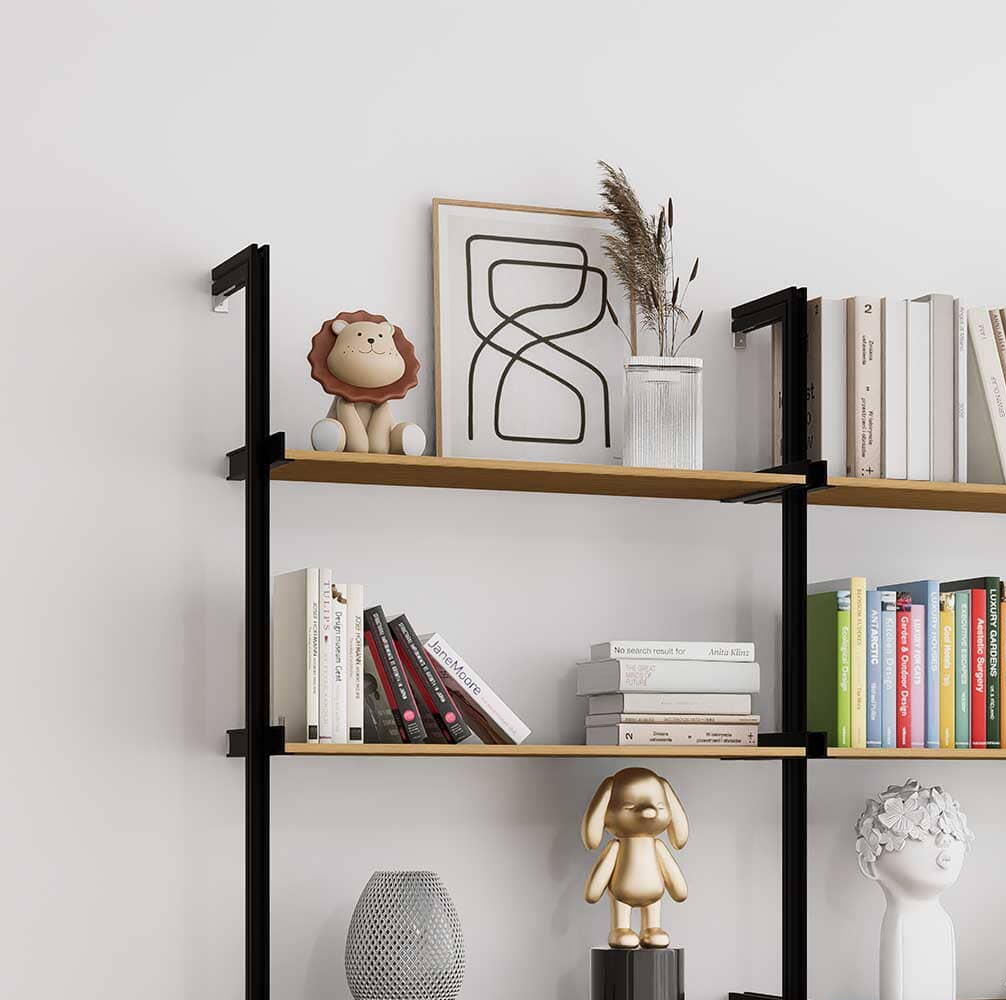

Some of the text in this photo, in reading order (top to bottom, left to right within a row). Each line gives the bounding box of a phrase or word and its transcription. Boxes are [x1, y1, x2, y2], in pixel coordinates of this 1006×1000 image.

[864, 304, 872, 314] 2
[323, 580, 331, 631] TULIPS
[334, 611, 342, 635] Design
[871, 609, 879, 664] ANTARCTIC
[886, 617, 894, 656] Kitchen
[901, 616, 909, 644] Garden
[614, 646, 686, 655] No search result for
[708, 647, 729, 657] Anita
[901, 654, 909, 688] Outdoor
[975, 656, 985, 694] Surgery
[899, 690, 909, 717] Design
[625, 732, 633, 740] 2
